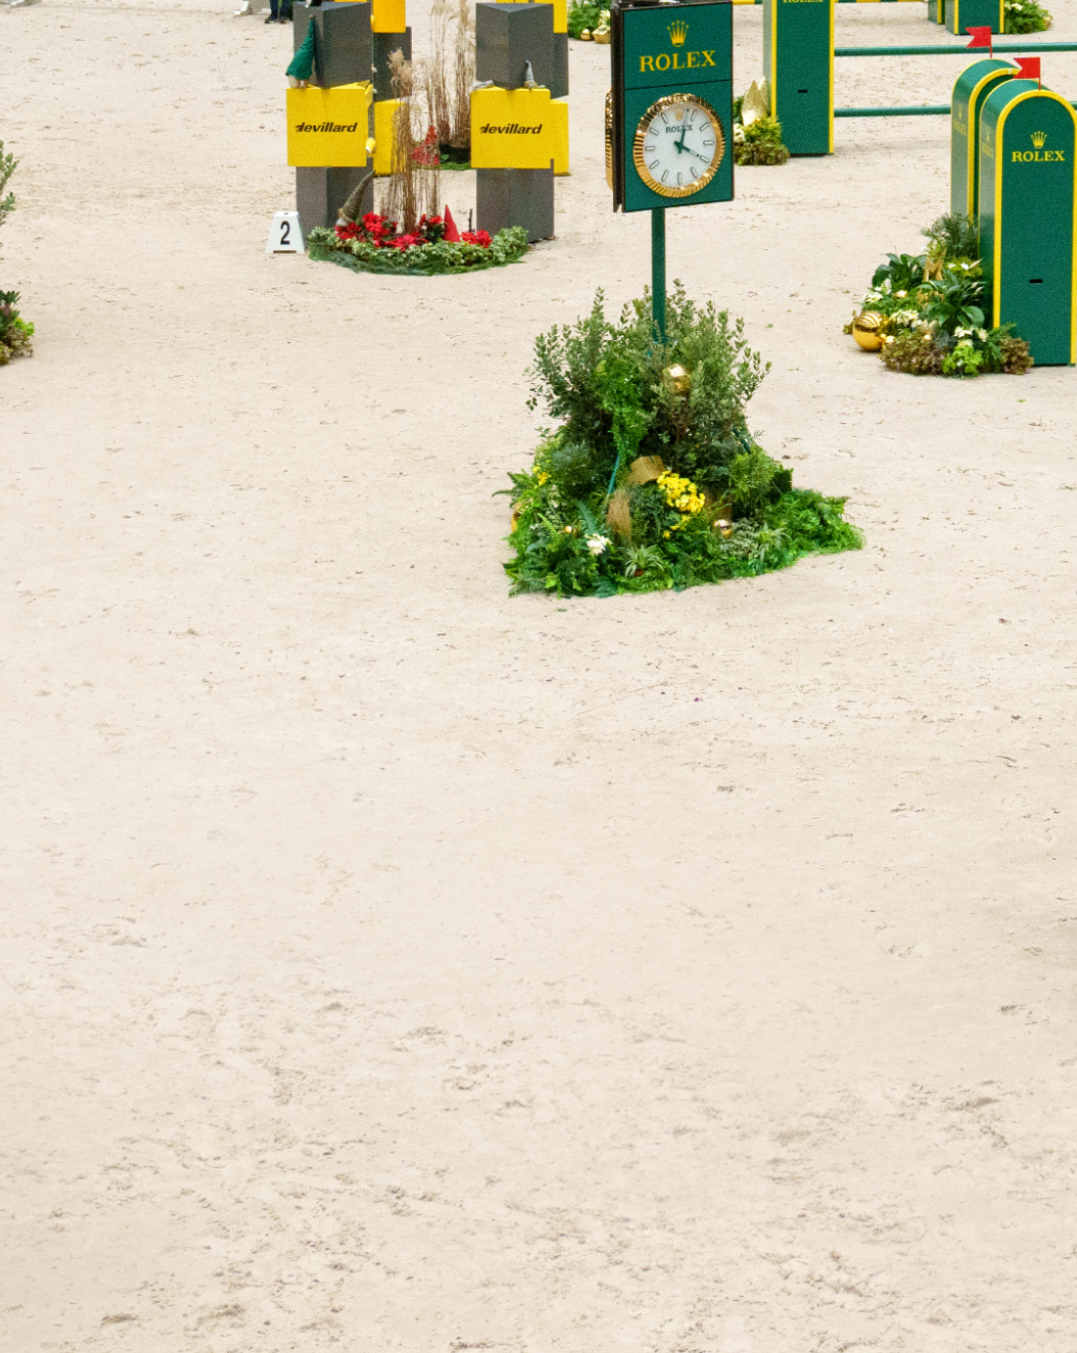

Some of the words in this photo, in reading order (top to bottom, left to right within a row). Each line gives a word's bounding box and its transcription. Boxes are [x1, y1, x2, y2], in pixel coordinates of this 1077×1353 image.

[639, 50, 716, 72] ROLEX
[295, 122, 358, 133] devillard
[480, 124, 543, 135] devillard
[1012, 150, 1065, 162] ROLEX
[279, 221, 291, 246] 2
